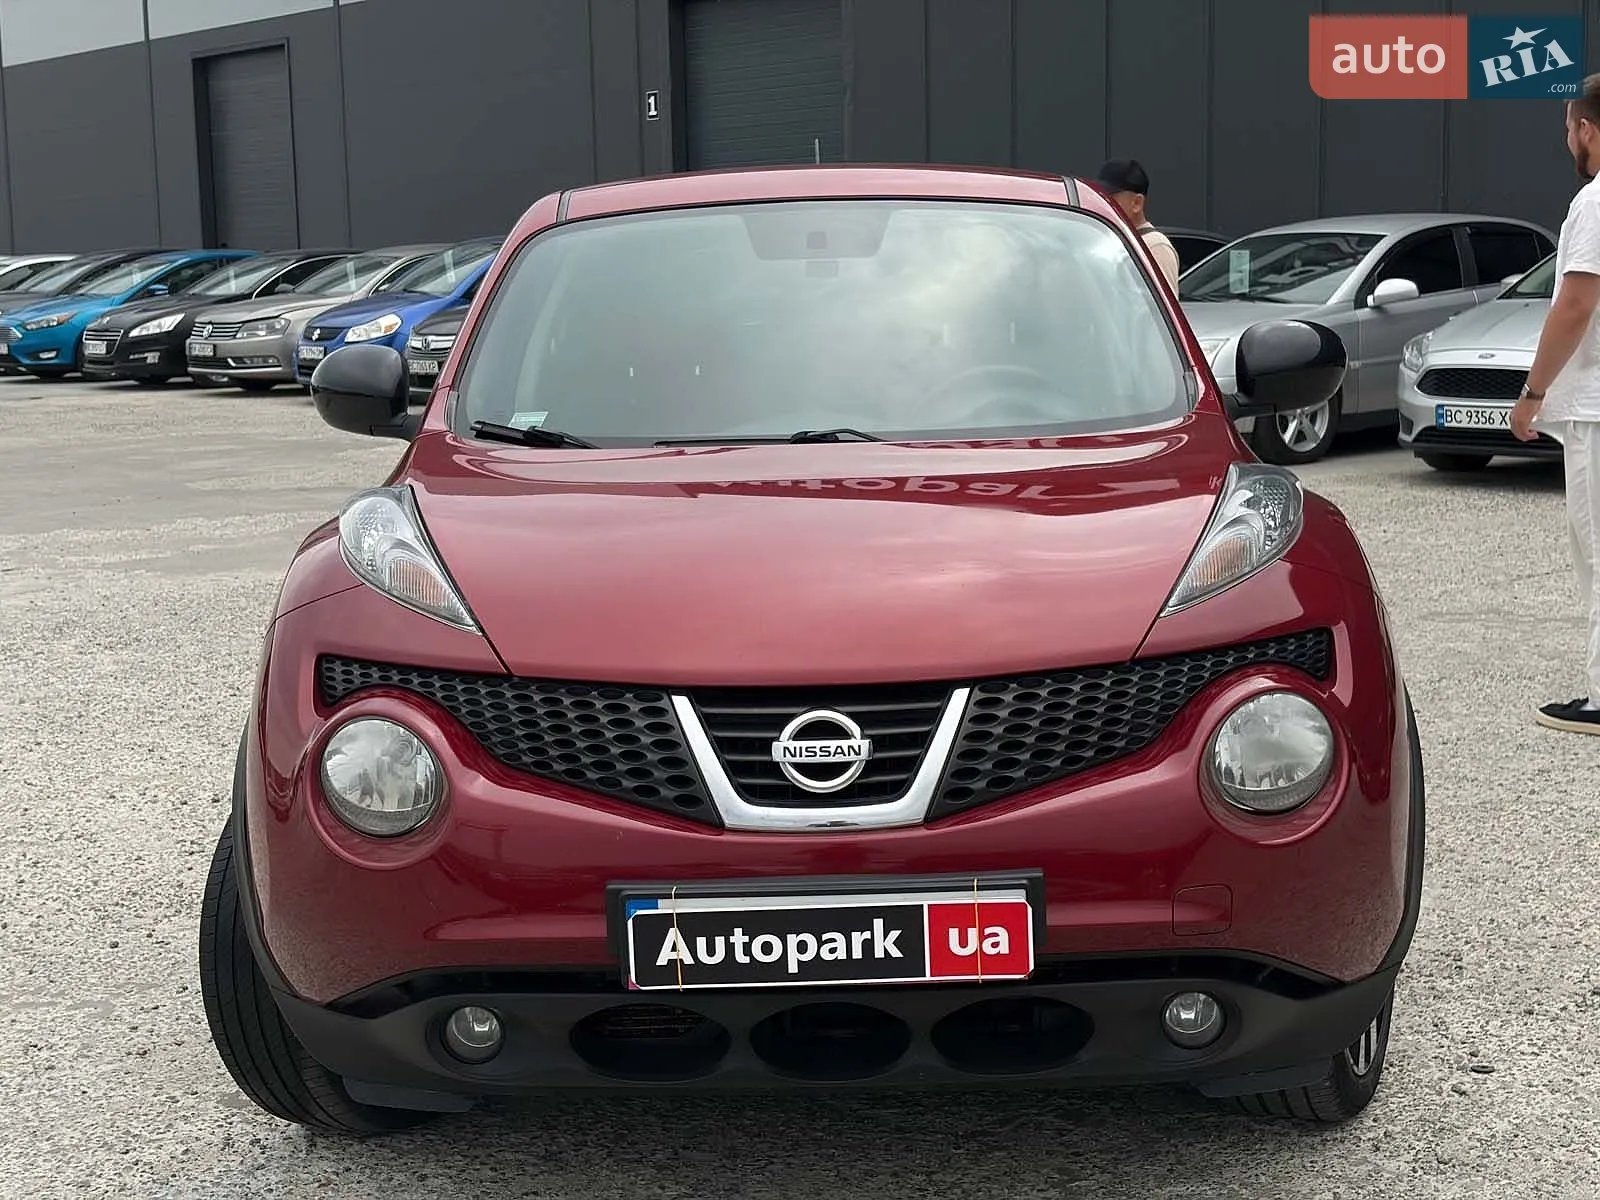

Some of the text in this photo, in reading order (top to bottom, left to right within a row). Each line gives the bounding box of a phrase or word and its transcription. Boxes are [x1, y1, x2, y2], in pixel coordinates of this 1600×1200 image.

[648, 95, 658, 116] 1
[1445, 409, 1511, 426] BC 9356 X
[783, 744, 862, 758] NISSAN
[655, 918, 1010, 974] Autopark ua
